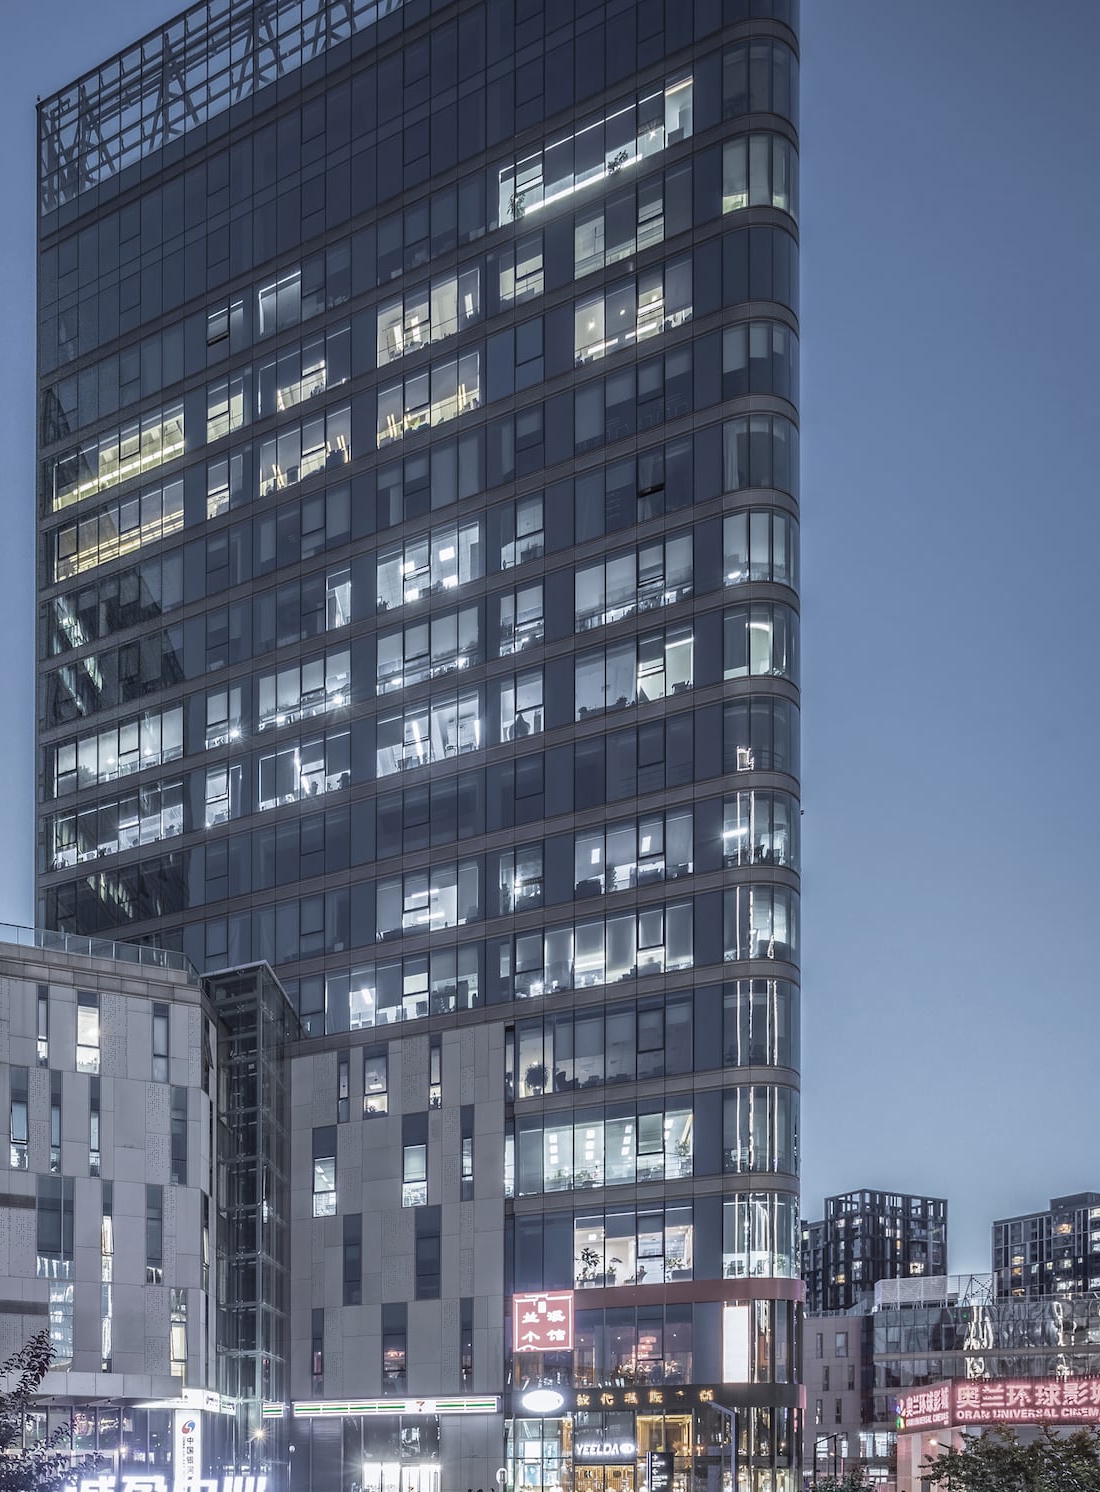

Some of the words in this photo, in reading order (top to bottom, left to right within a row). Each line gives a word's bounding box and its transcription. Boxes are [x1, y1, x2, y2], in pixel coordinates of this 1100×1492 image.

[956, 1409, 990, 1420] ORAN
[992, 1408, 1058, 1419] UNIVERSAL
[1060, 1407, 1100, 1417] CINEM
